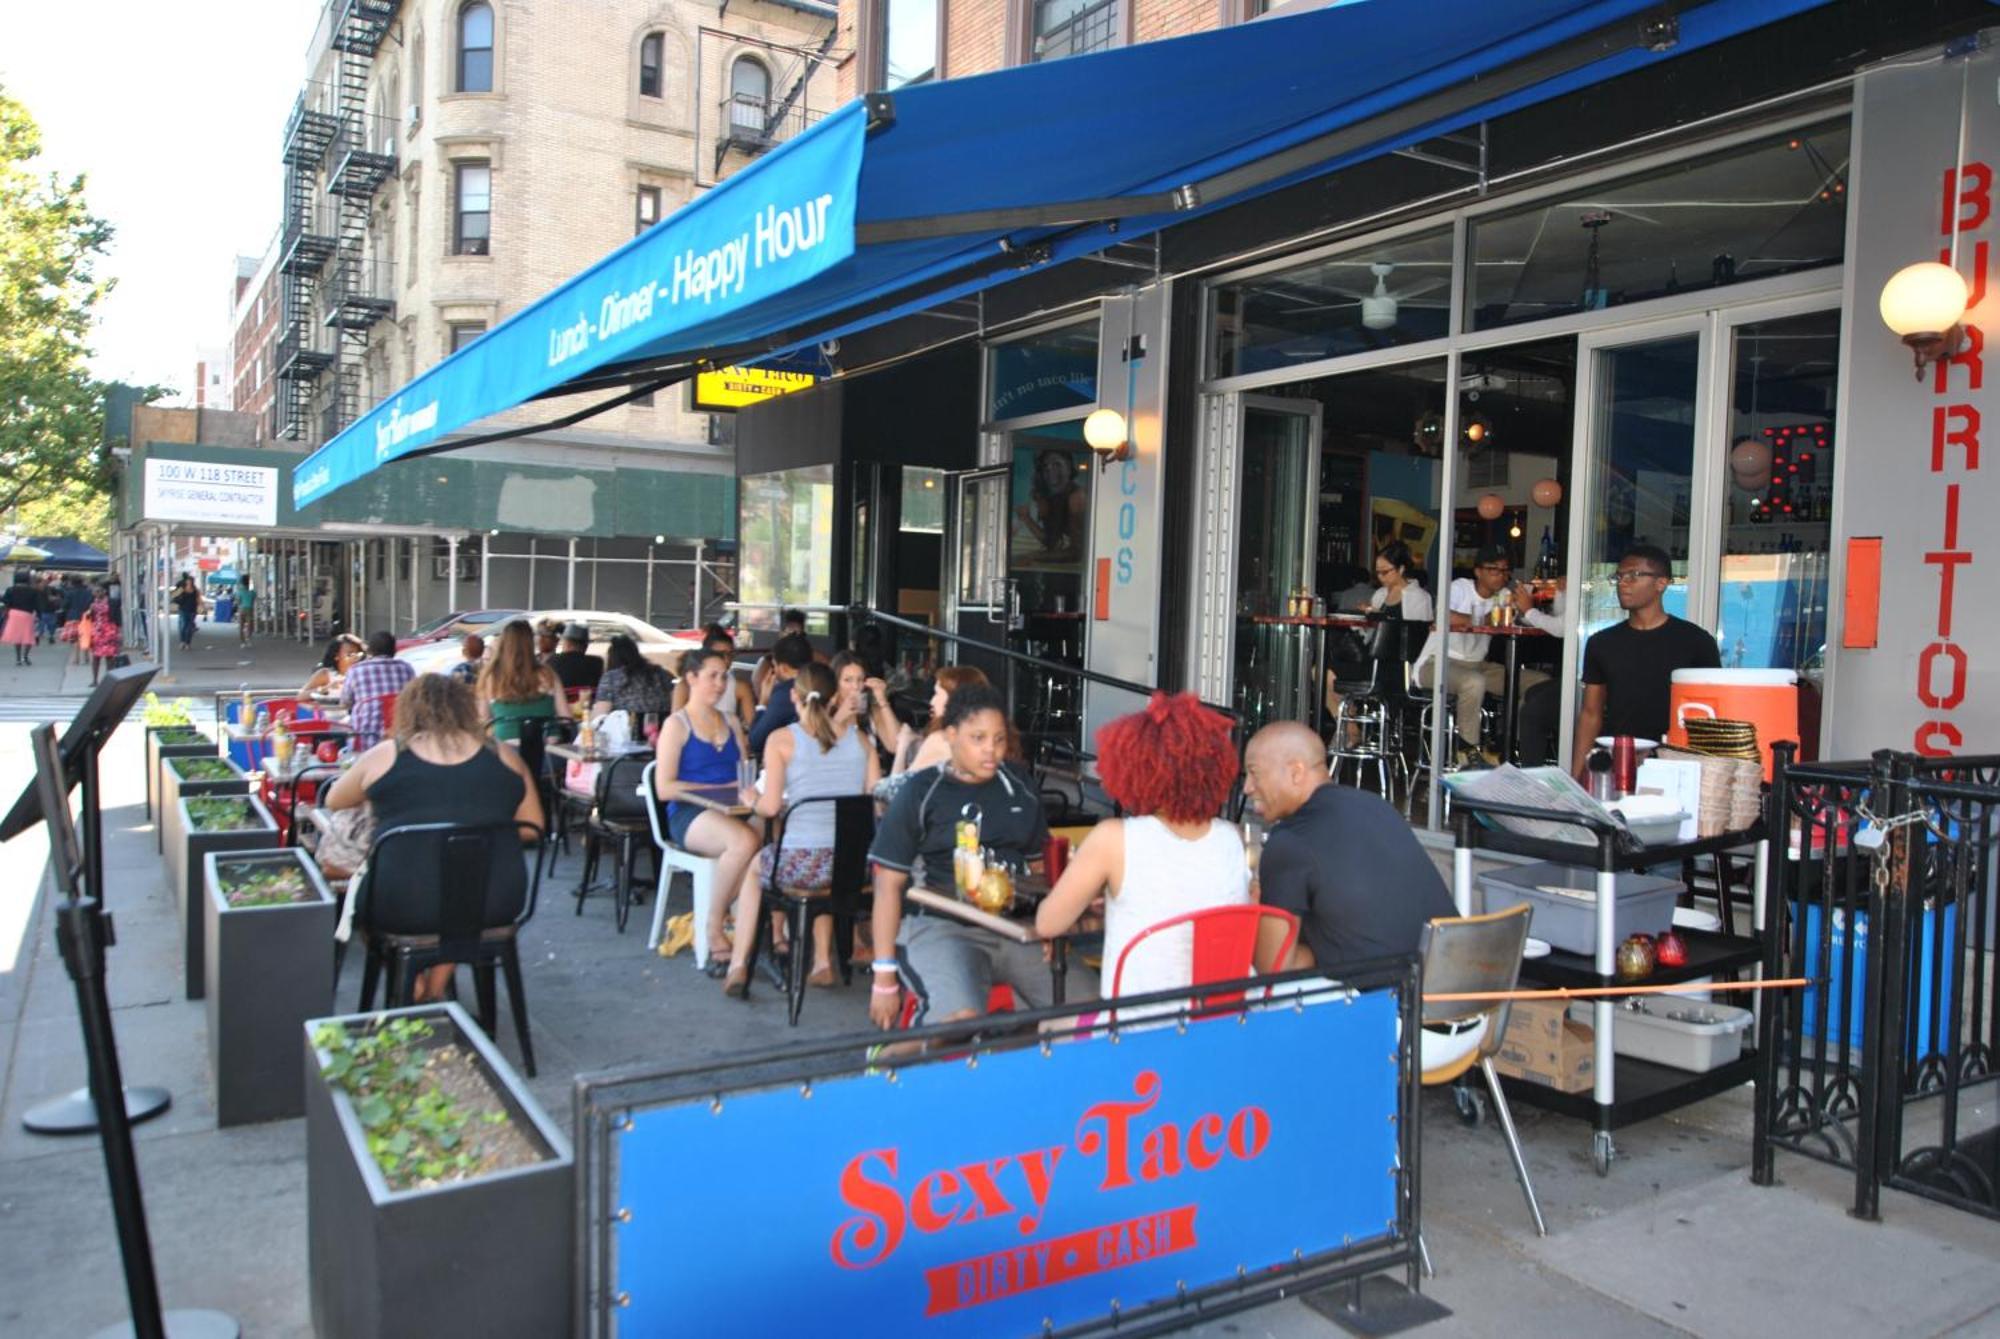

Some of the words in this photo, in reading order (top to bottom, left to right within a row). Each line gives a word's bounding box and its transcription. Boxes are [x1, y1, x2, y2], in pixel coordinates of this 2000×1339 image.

[549, 311, 589, 367] Lunch
[598, 280, 657, 341] Dinner
[671, 232, 749, 304] Happy
[755, 193, 833, 269] Hour
[159, 464, 181, 479] 100
[184, 466, 197, 480] W
[200, 468, 221, 481] 118
[223, 469, 265, 485] STREET
[1117, 357, 1142, 584] TCOS
[830, 1146, 1067, 1271] Sexy
[1075, 1069, 1273, 1192] Taco
[958, 1247, 1050, 1304] DIRTY
[1097, 1215, 1172, 1268] CASH
